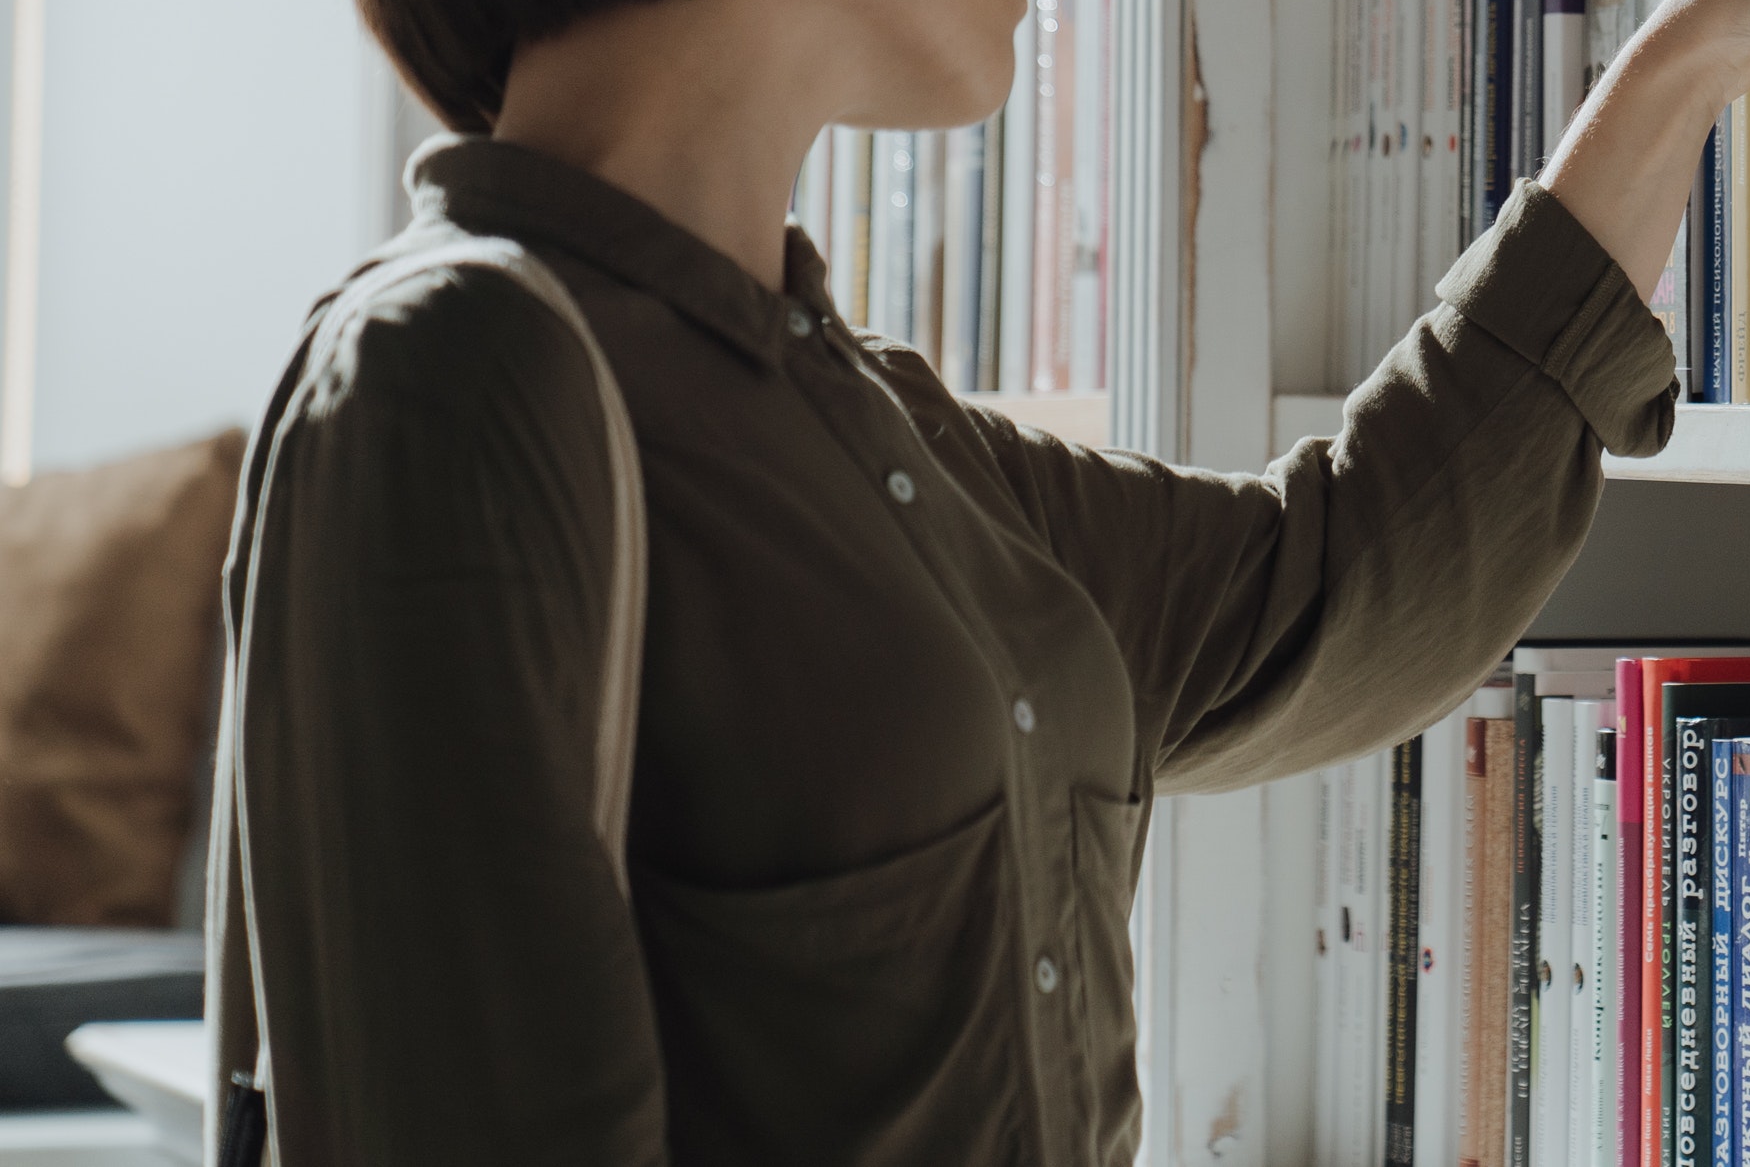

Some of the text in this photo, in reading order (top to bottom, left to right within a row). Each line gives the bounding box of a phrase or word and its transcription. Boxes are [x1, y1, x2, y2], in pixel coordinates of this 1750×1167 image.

[1711, 136, 1723, 388] КРАТКИЙ ПСИХОЛОГИЧЕСКИЙ
[1736, 310, 1747, 382] ФРЕЙД
[1645, 725, 1656, 963] Семь преобразующих языков
[1661, 757, 1673, 1028] УКРОТИТЕЛЬ ТРОЛЛЕЙ
[1681, 728, 1705, 900] разговор
[1714, 757, 1731, 912] ДИСКУРС
[1737, 798, 1749, 858] Питер
